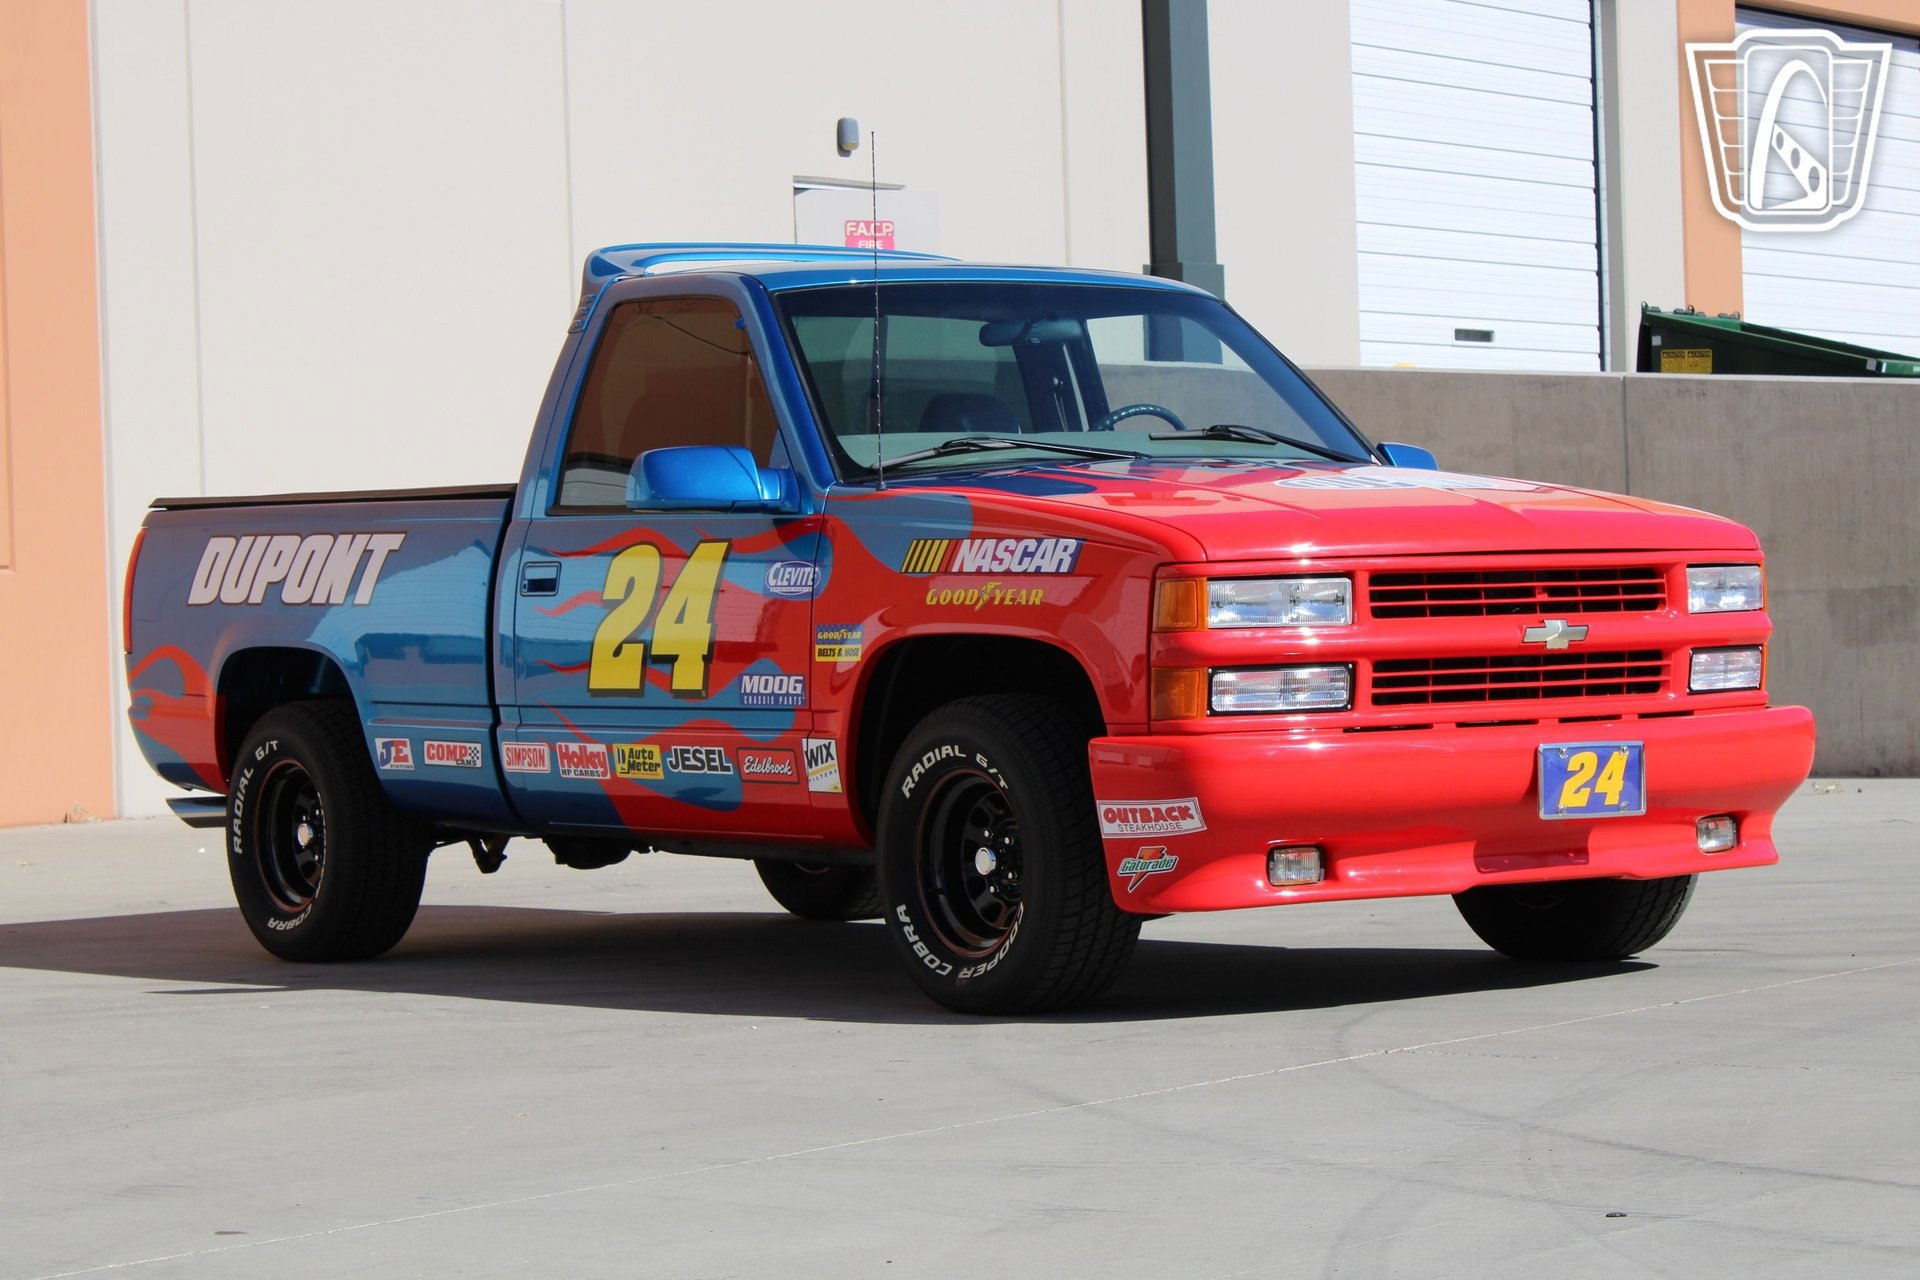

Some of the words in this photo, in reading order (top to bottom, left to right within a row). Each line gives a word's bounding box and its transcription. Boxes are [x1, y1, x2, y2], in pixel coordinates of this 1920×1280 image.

[858, 240, 884, 250] FIRE
[951, 538, 1077, 573] NASCAR
[187, 532, 407, 606] DUPONT
[769, 562, 819, 587] CLEVITE
[588, 540, 732, 697] 24
[817, 648, 836, 657] BELTS
[741, 675, 804, 695] MOOG
[743, 695, 775, 705] CHASSIS
[779, 696, 802, 706] PARTS
[380, 740, 410, 767] JE
[426, 743, 468, 762] COMP
[456, 759, 478, 767] CAMS
[505, 746, 546, 768] SIMPSON
[557, 744, 608, 777] Holley
[628, 747, 654, 760] Auto
[668, 746, 733, 774] JESEL
[804, 741, 835, 769] WIX
[561, 768, 573, 776] HP
[574, 769, 601, 778] CARBS
[628, 760, 661, 773] Meter
[744, 755, 793, 776] Edelbrock
[901, 745, 967, 798] RADIAL
[975, 752, 1009, 790] G/T
[1559, 751, 1629, 808] 24
[232, 767, 254, 854] RADIAL
[254, 740, 279, 761] G/T
[1103, 805, 1195, 824] OUTBACK
[1117, 821, 1183, 832] STEAKHOUSE
[1121, 858, 1175, 872] Gatorade
[896, 904, 953, 976] COBRA
[958, 901, 1024, 979] COOPER
